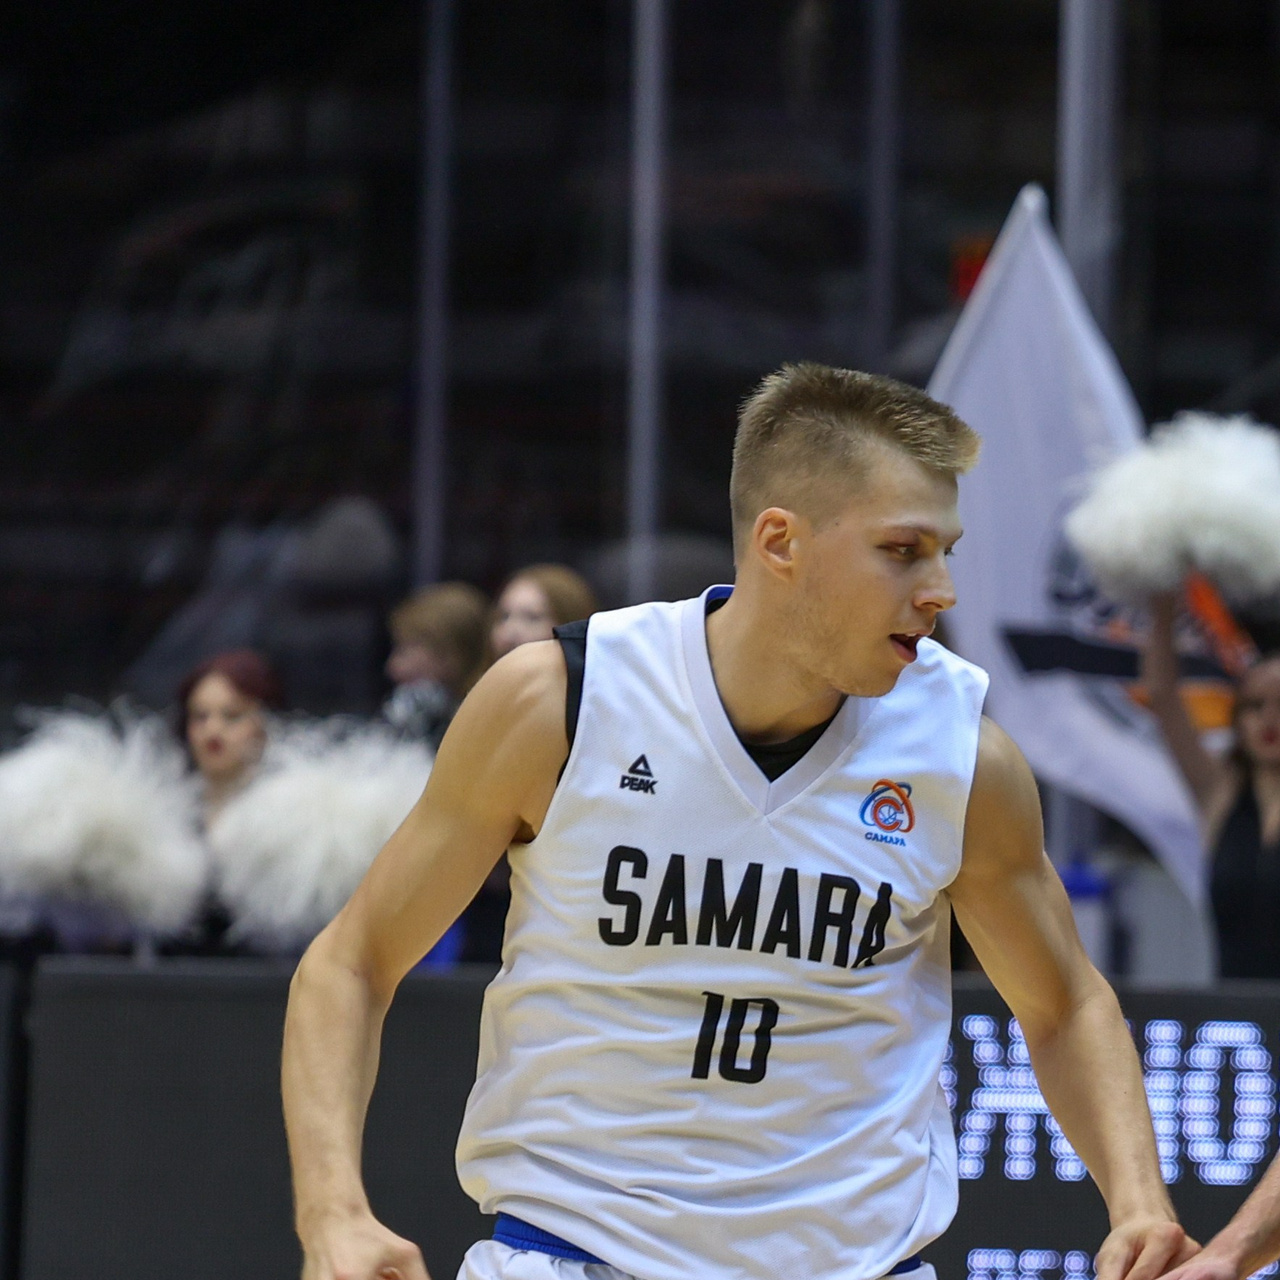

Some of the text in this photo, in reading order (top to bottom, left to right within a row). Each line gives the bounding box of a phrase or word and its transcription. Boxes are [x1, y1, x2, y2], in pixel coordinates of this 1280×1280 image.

[619, 774, 658, 795] PEAK
[598, 845, 893, 969] SAMARA
[691, 990, 780, 1085] 10
